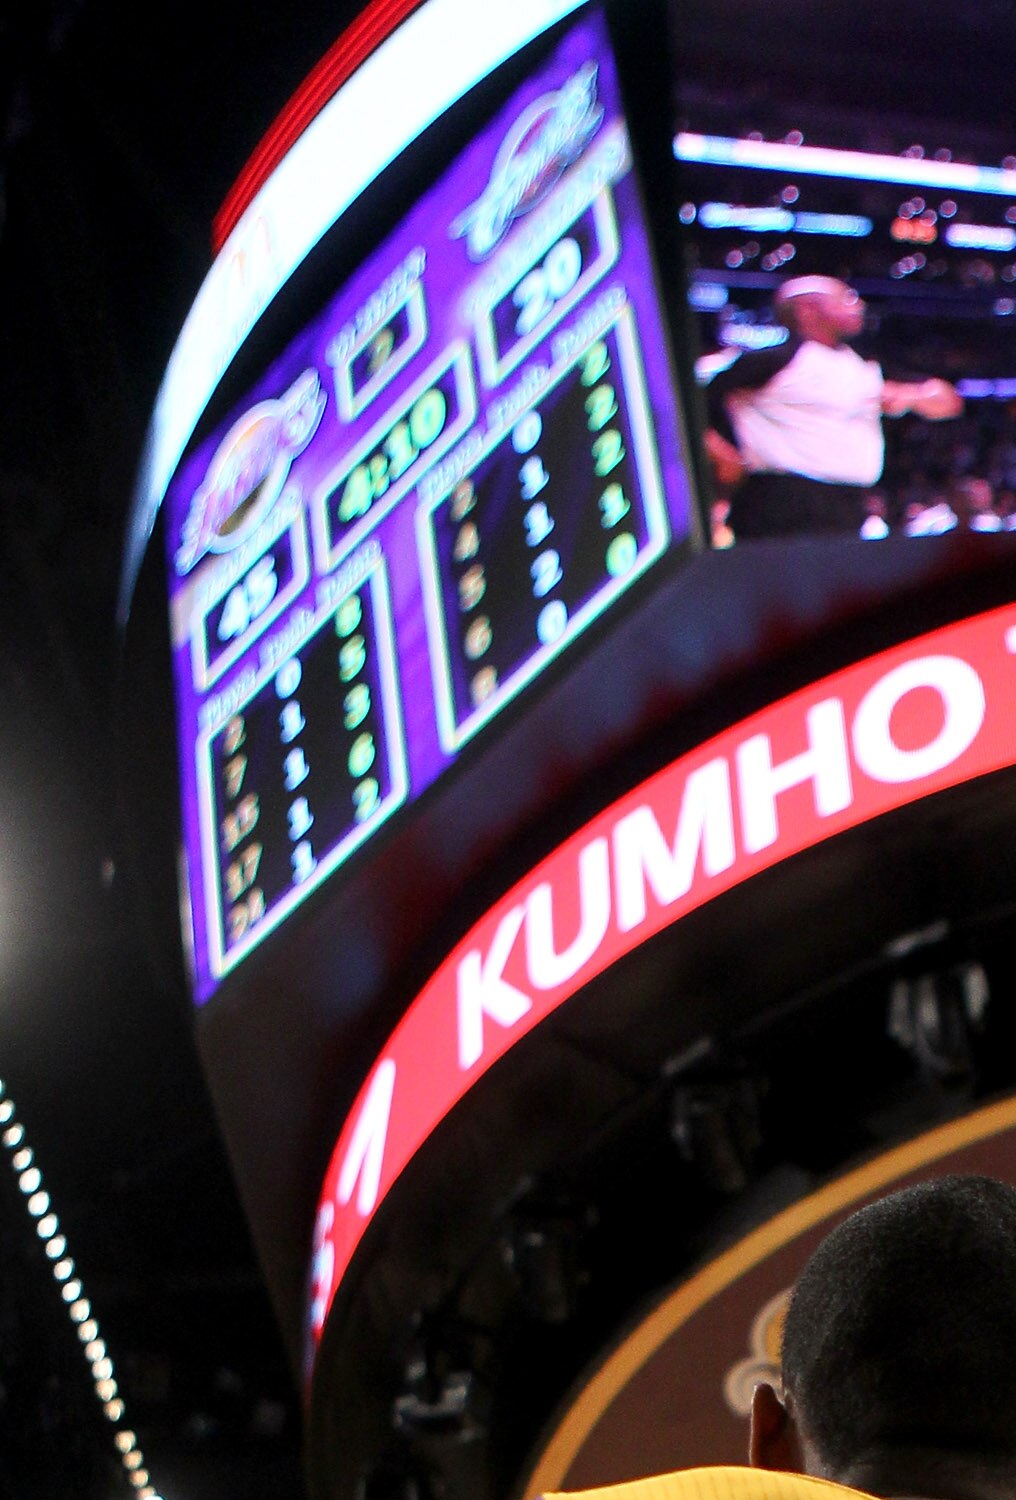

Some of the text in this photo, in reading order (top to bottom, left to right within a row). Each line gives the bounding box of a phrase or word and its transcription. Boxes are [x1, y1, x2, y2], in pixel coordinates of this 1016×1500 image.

[512, 237, 582, 336] 20
[512, 410, 542, 454] 0
[581, 340, 611, 387] 2
[519, 454, 549, 500] 1
[585, 383, 618, 431] 2
[337, 388, 447, 523] 4:10
[459, 429, 625, 612] 5 1 2
[465, 482, 631, 660] 6 2 1
[217, 553, 278, 641] 45
[537, 600, 567, 646] 0
[606, 532, 637, 578] 0
[275, 657, 302, 699] 0
[279, 700, 305, 744] 1
[339, 634, 366, 683] 5
[222, 792, 260, 853] 15
[283, 747, 309, 792] 1
[225, 732, 375, 902] 17 1 6
[291, 839, 317, 884] 1
[352, 777, 380, 823] 2
[457, 655, 987, 1073] KUMHO
